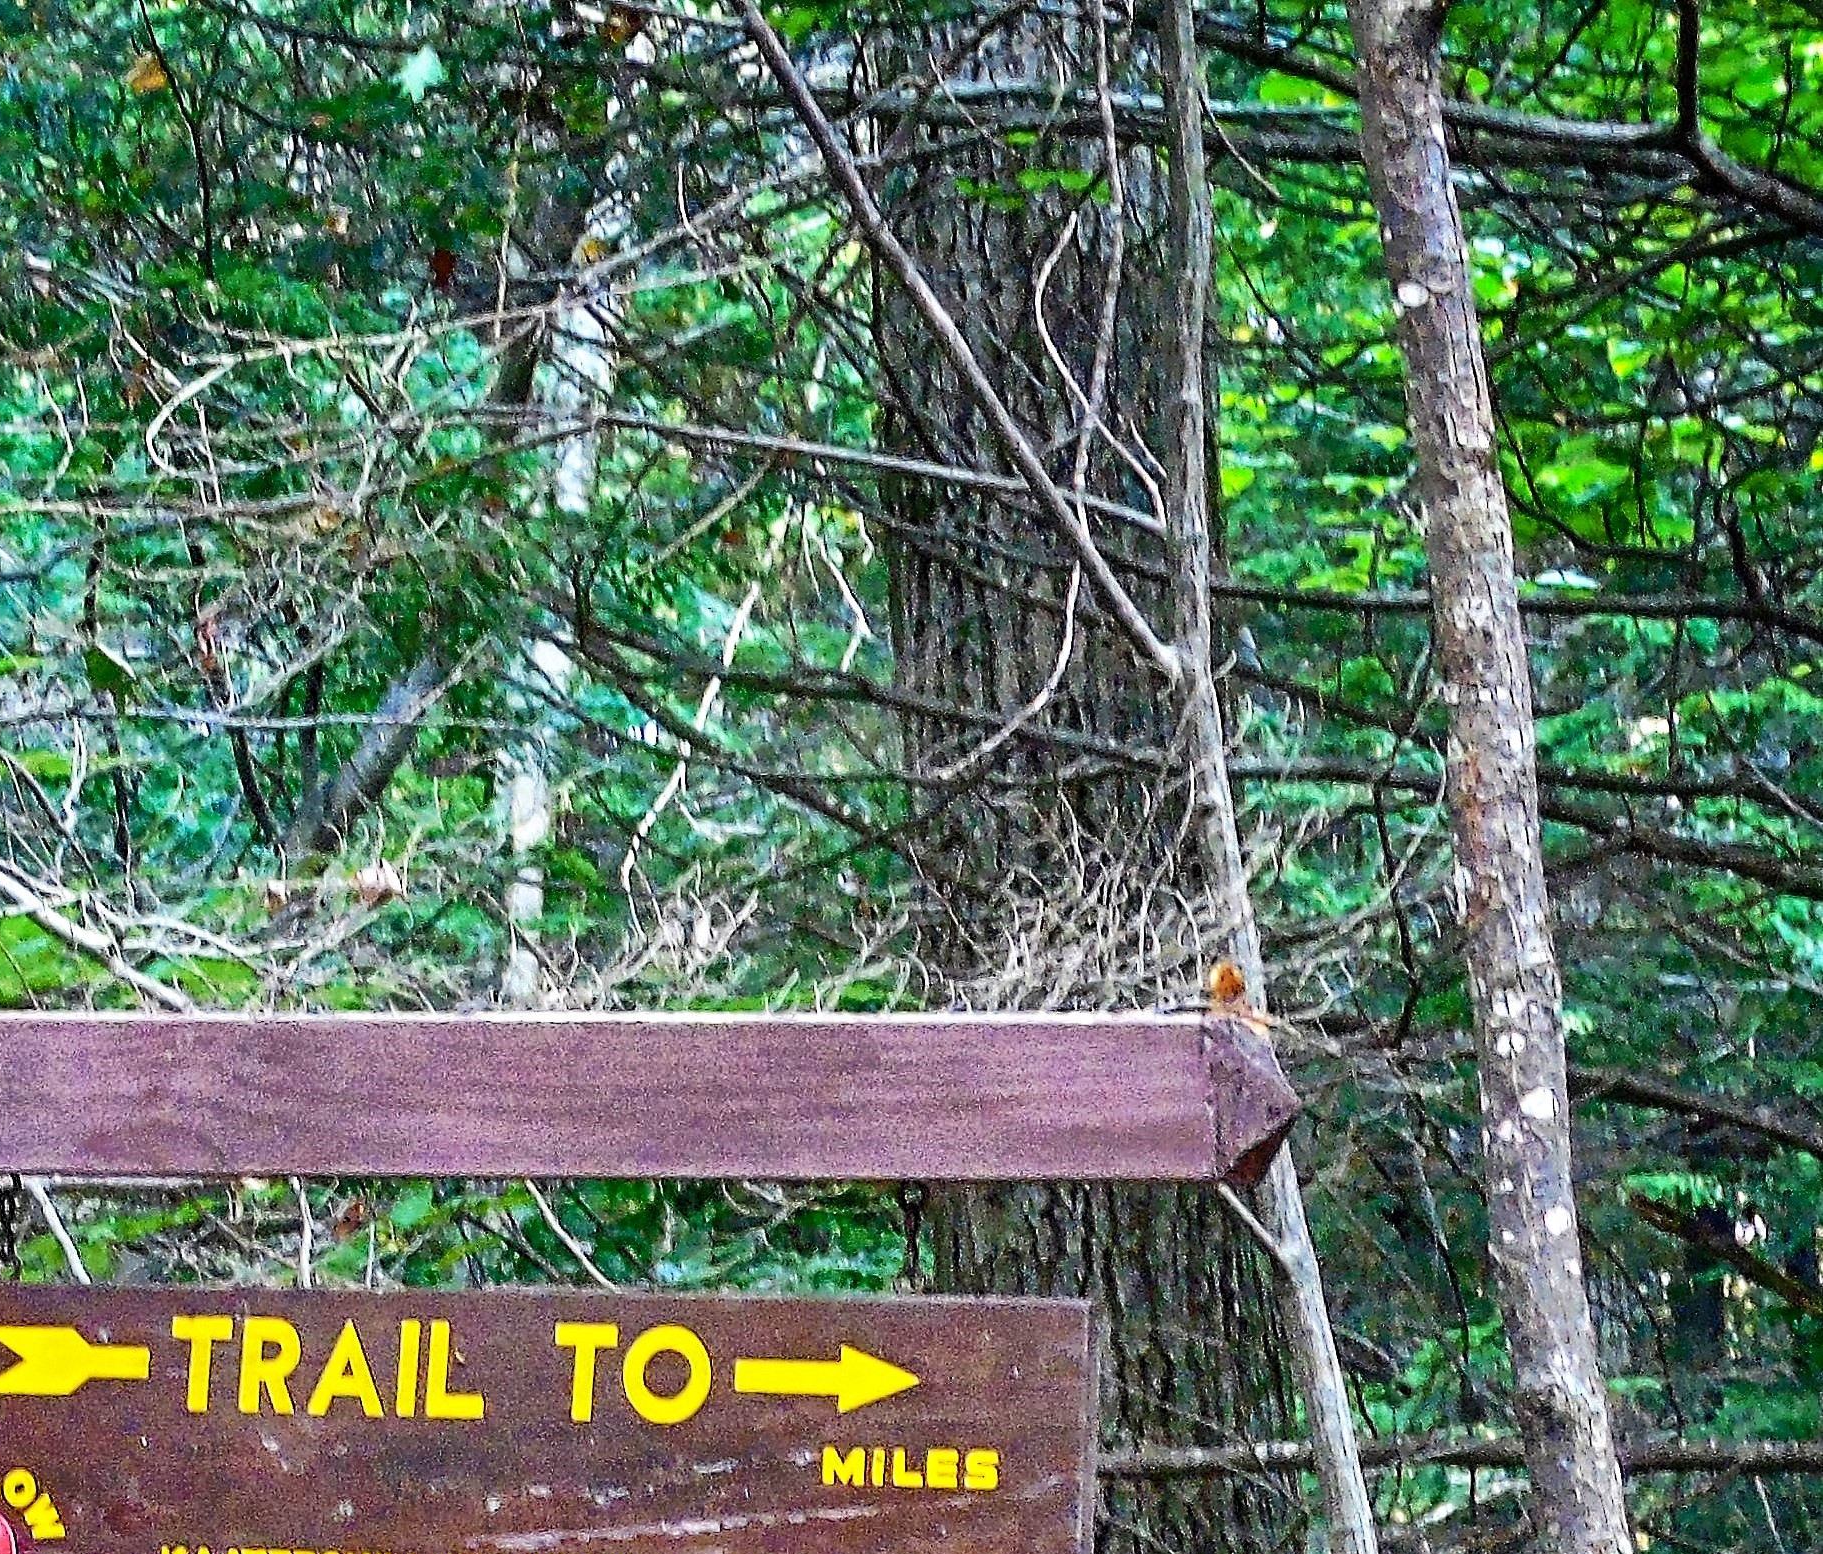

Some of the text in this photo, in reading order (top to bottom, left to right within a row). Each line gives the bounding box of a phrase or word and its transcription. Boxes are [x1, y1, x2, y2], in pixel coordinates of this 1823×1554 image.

[171, 1315, 713, 1425] TRAIL TO
[821, 1445, 1000, 1490] MILES
